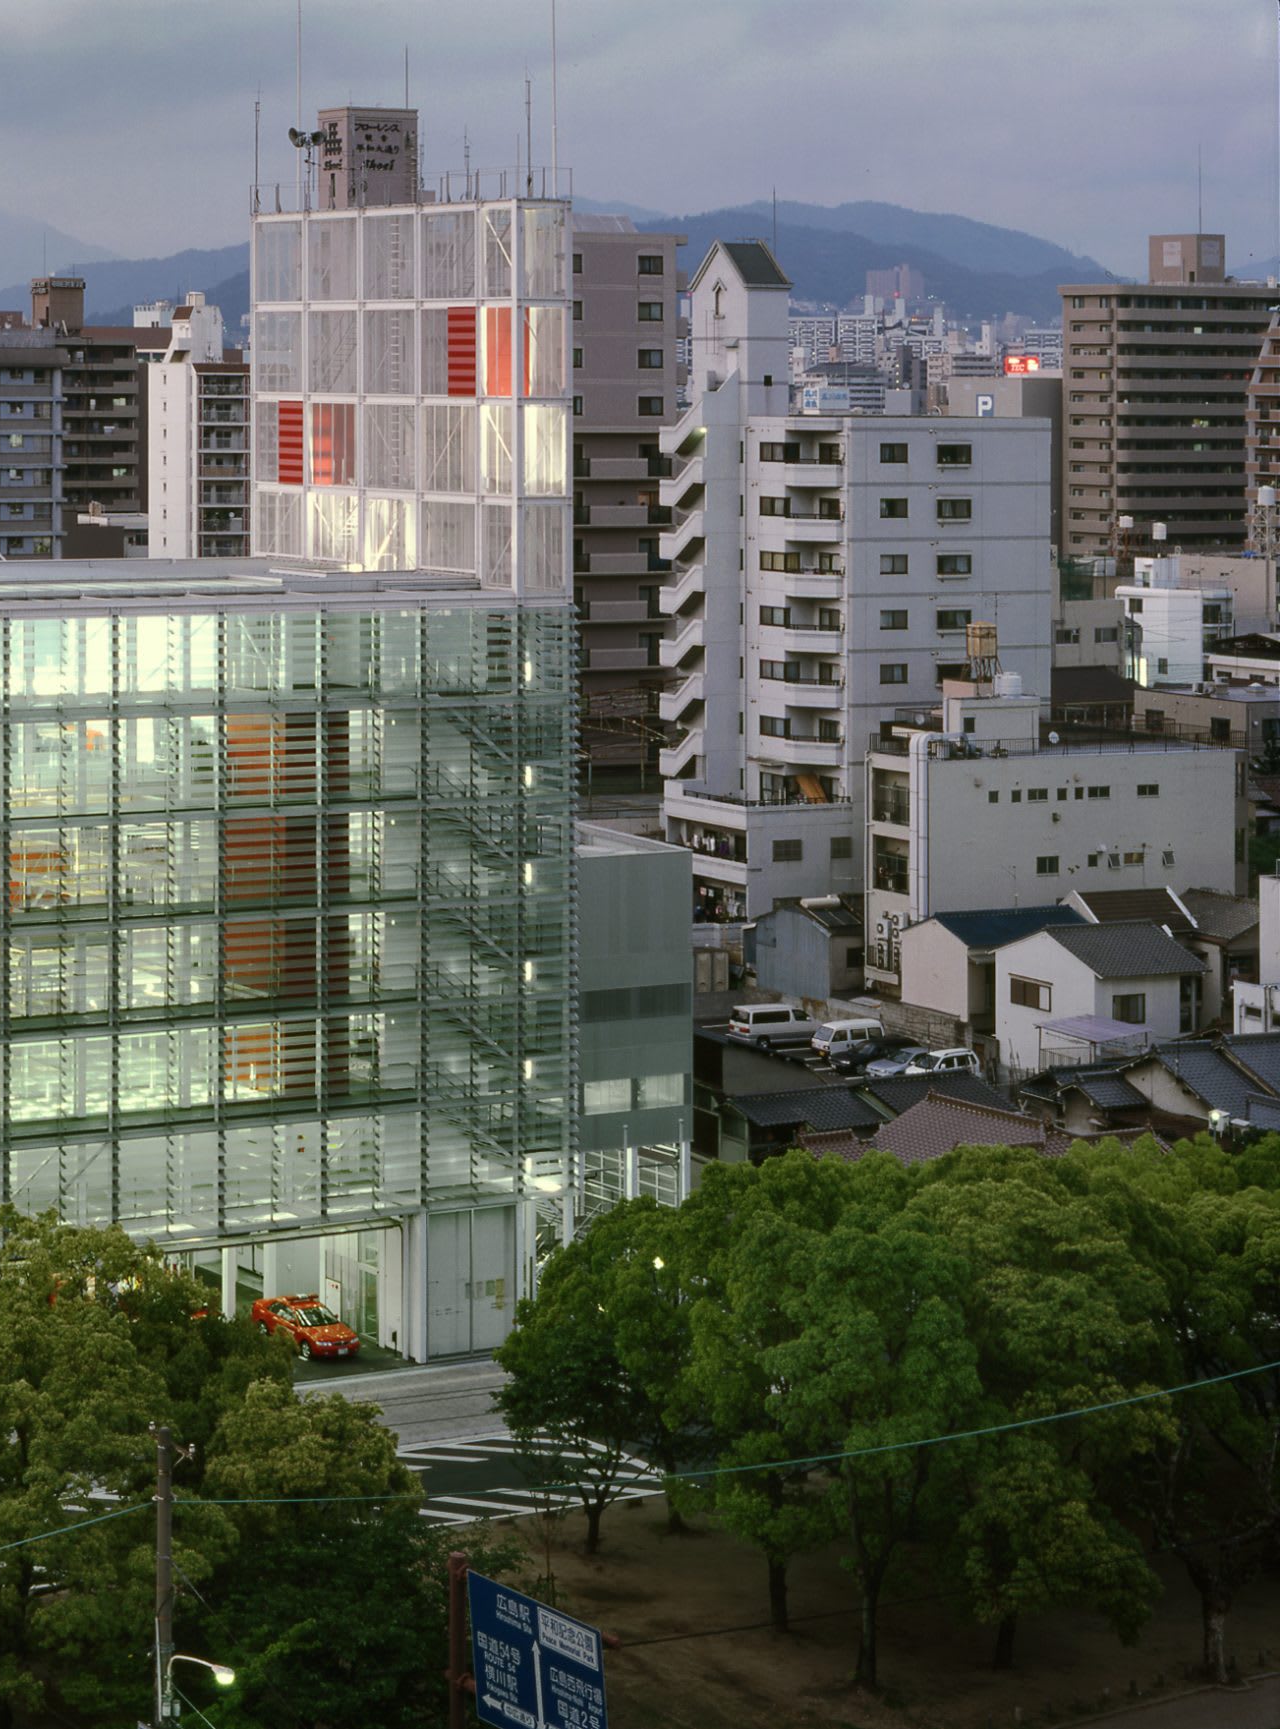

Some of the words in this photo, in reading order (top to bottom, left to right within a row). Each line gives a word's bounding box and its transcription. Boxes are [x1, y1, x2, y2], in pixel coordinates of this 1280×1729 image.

[978, 396, 992, 416] P
[496, 1593, 530, 1623] 広島駅
[541, 1614, 593, 1651] 平和記念公園
[477, 1631, 520, 1665] 国道54号
[484, 1652, 504, 1668] ROUTE
[485, 1664, 518, 1693] 横川駅
